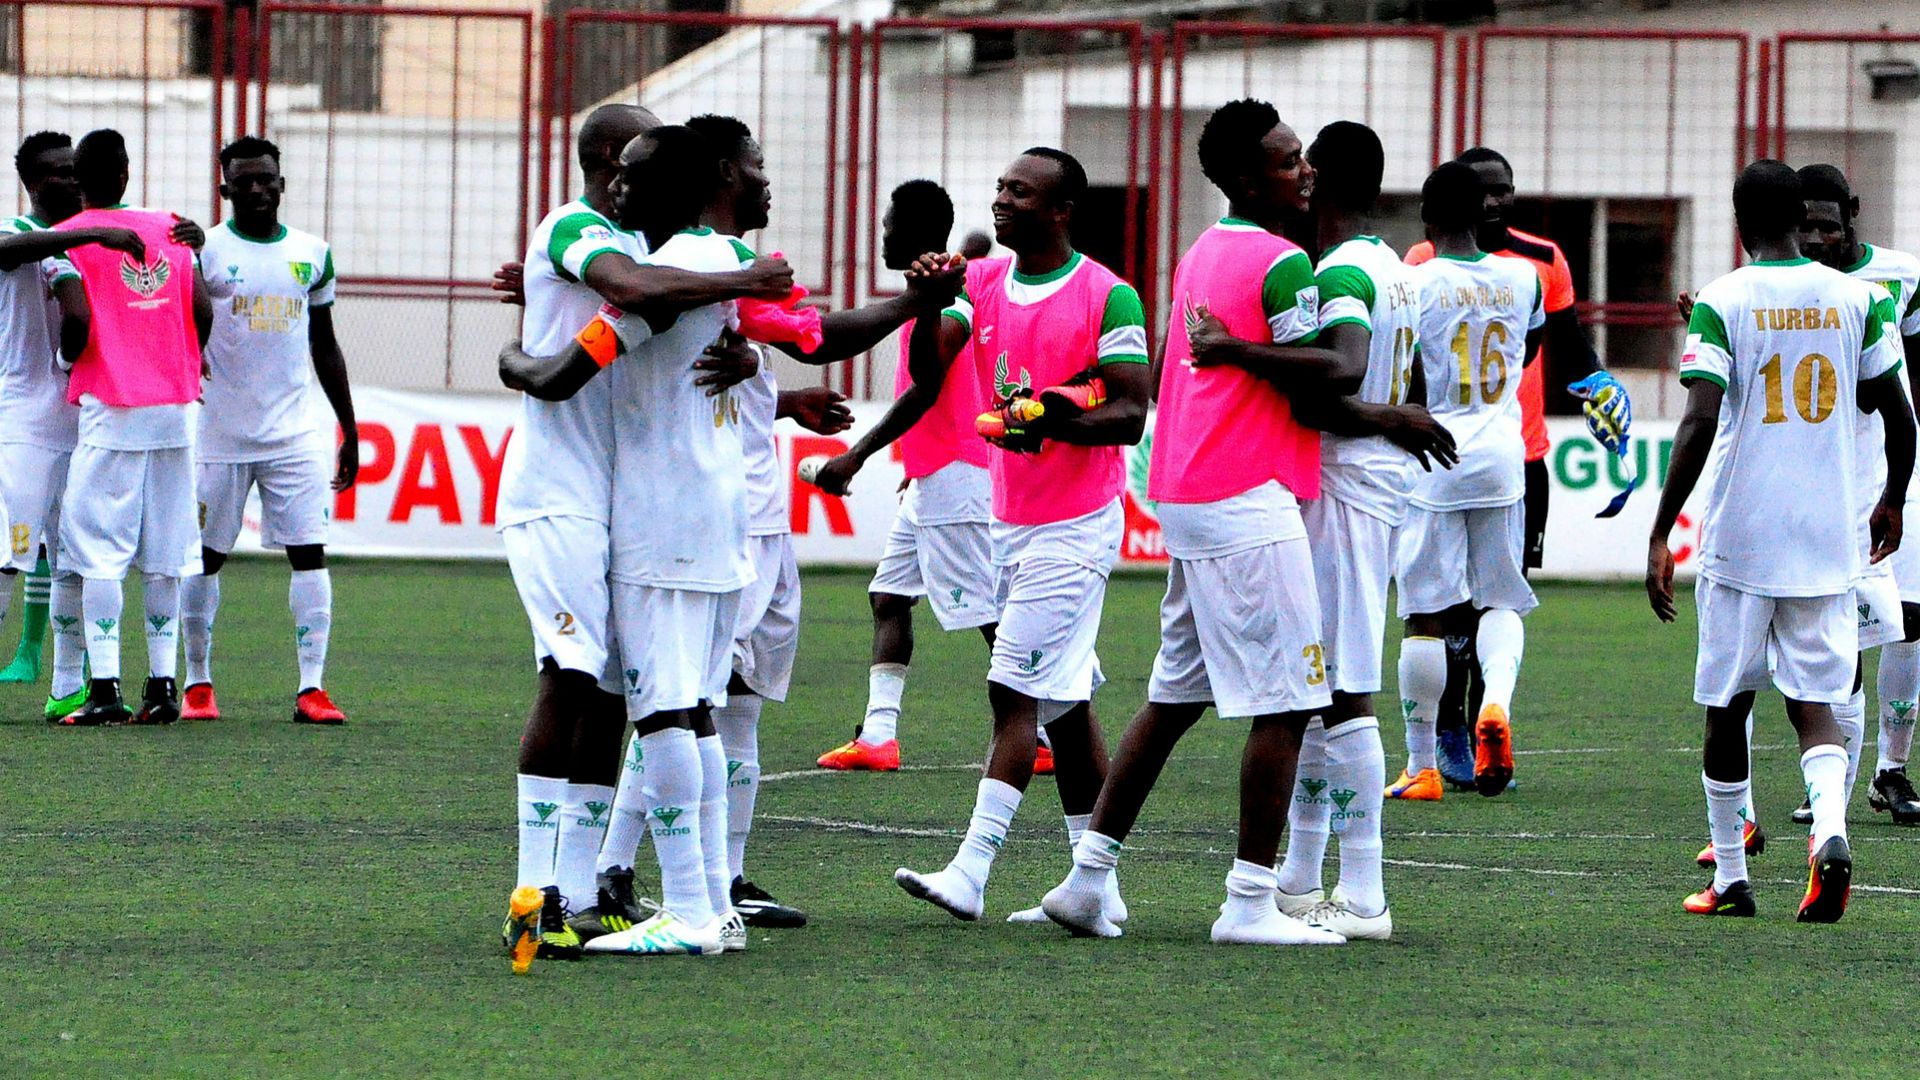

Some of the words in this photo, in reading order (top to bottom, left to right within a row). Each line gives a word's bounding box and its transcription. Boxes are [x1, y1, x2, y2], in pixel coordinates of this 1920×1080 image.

[1752, 308, 1841, 331] TURBA
[1450, 321, 1507, 406] 16
[1759, 353, 1837, 424] 10
[333, 420, 513, 526] PAY
[554, 612, 576, 635] 2
[1302, 644, 1325, 686] 3
[625, 759, 645, 774] con
